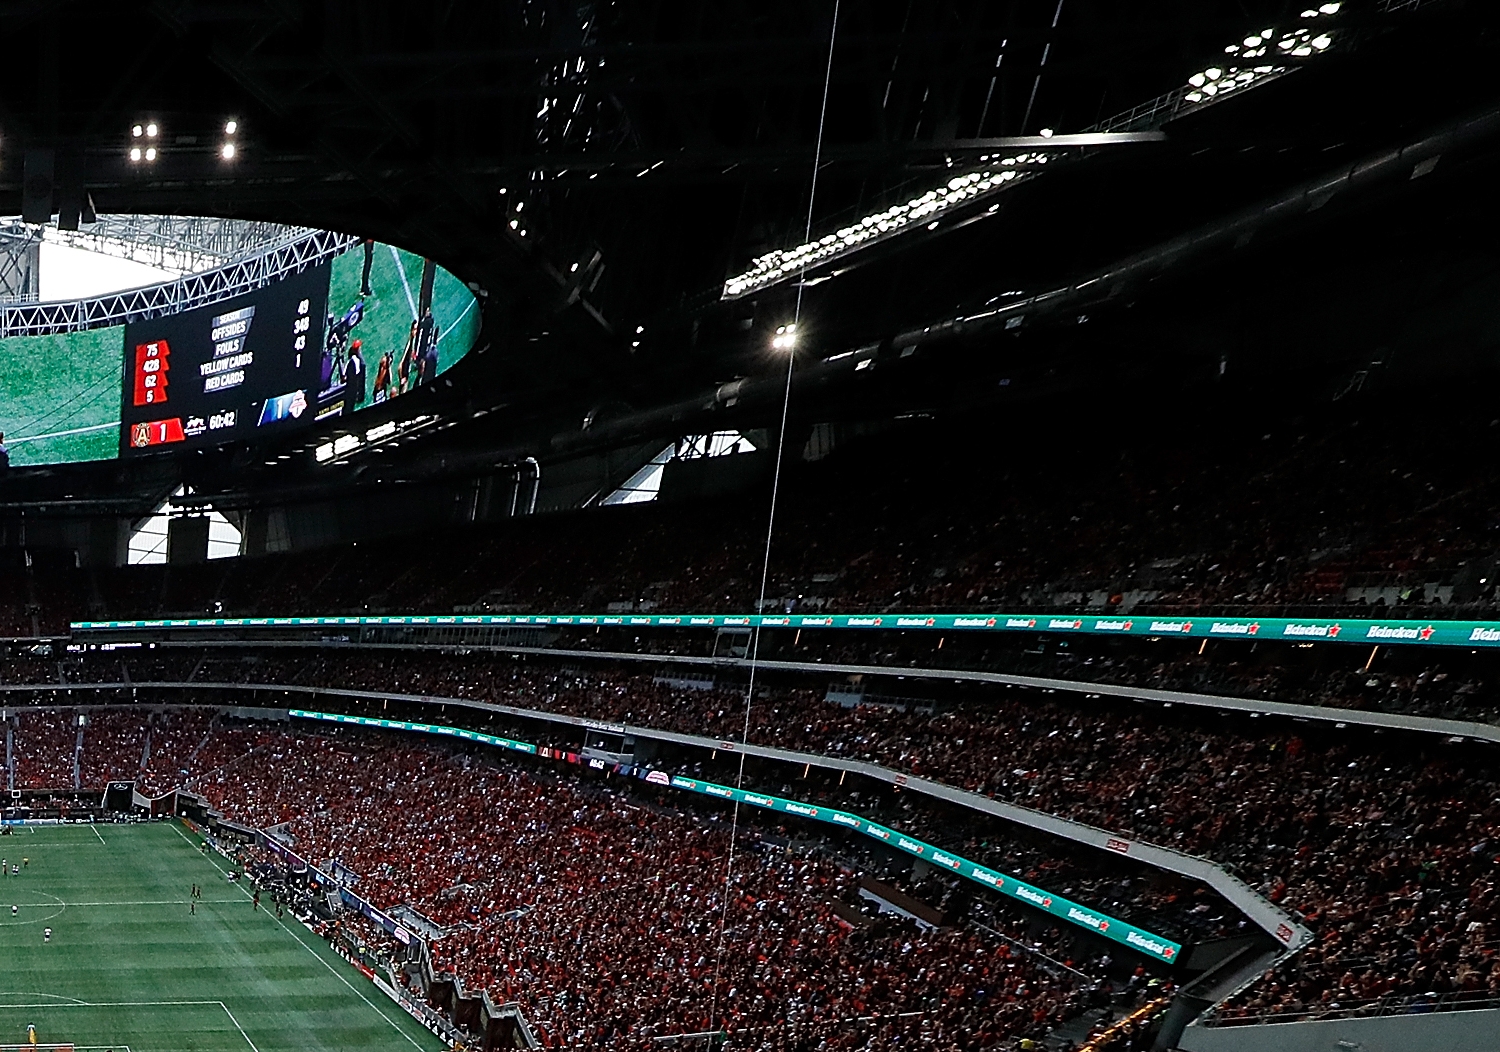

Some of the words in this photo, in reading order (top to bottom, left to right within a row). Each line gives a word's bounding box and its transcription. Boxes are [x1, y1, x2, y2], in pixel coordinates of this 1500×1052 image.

[297, 300, 310, 316] 49
[211, 320, 247, 341] OFFSIDES
[147, 343, 158, 357] 75
[215, 338, 240, 357] FOULS
[294, 334, 306, 351] 43
[200, 356, 229, 376] YELLOW
[228, 351, 253, 370] CARDS
[295, 353, 301, 369] 1
[144, 374, 156, 388] 62
[205, 376, 220, 391] RED
[219, 370, 245, 388] CARDS
[146, 389, 153, 403] 5
[276, 399, 283, 419] 1
[209, 411, 235, 430] 60:42
[160, 423, 167, 441] 1
[1366, 625, 1421, 639] Heineken
